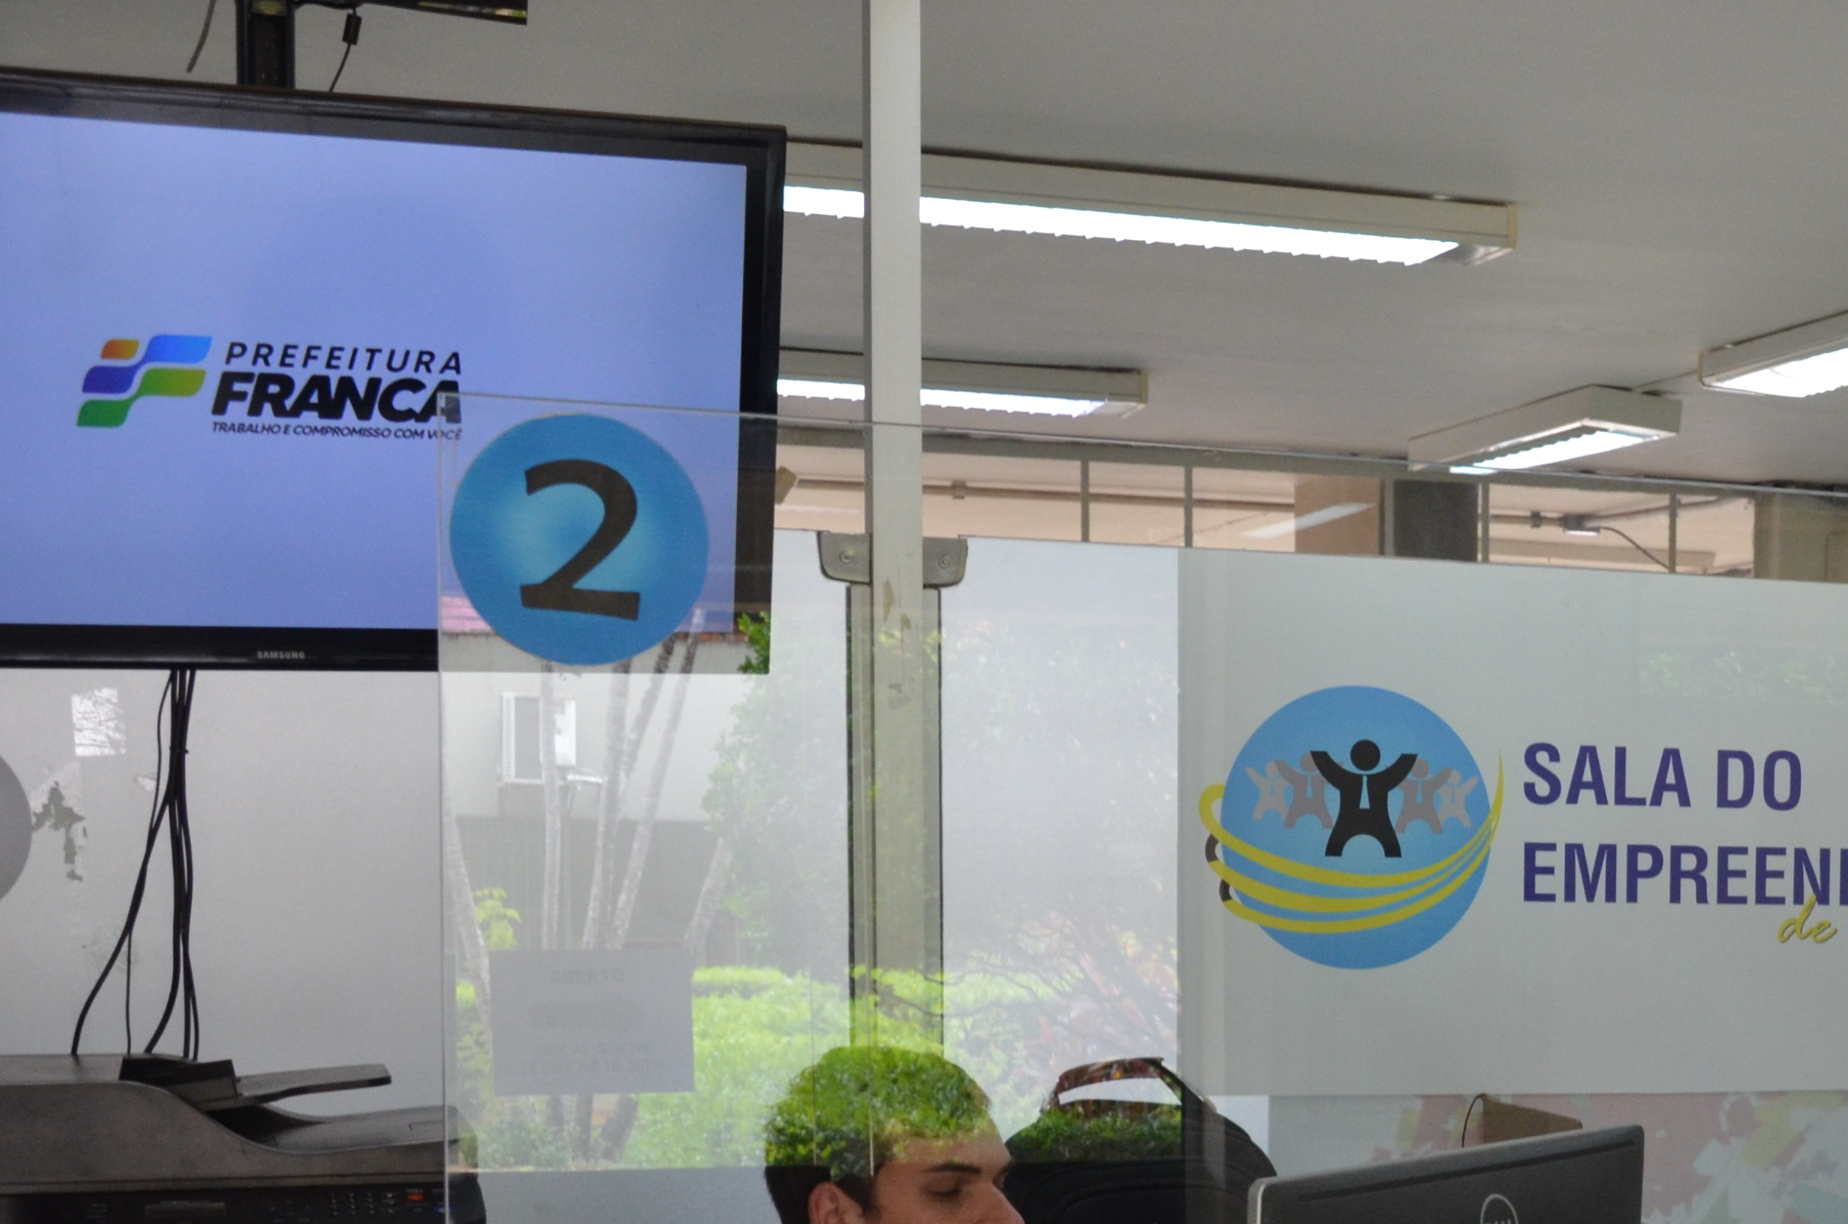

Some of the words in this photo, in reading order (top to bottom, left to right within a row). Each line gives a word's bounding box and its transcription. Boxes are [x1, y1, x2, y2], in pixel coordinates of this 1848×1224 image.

[225, 342, 461, 374] PREFEITURA
[211, 371, 462, 423] FRANCA
[212, 422, 281, 435] TRABALHO
[284, 424, 291, 435] E
[293, 425, 392, 438] COMPROMISSO
[394, 428, 424, 439] COM
[426, 428, 462, 440] VOCÊ
[520, 459, 640, 621] 2
[257, 651, 305, 659] SAMSUNG
[1523, 742, 1691, 807] SALA
[1717, 749, 1802, 811] DO
[1777, 894, 1837, 944] de
